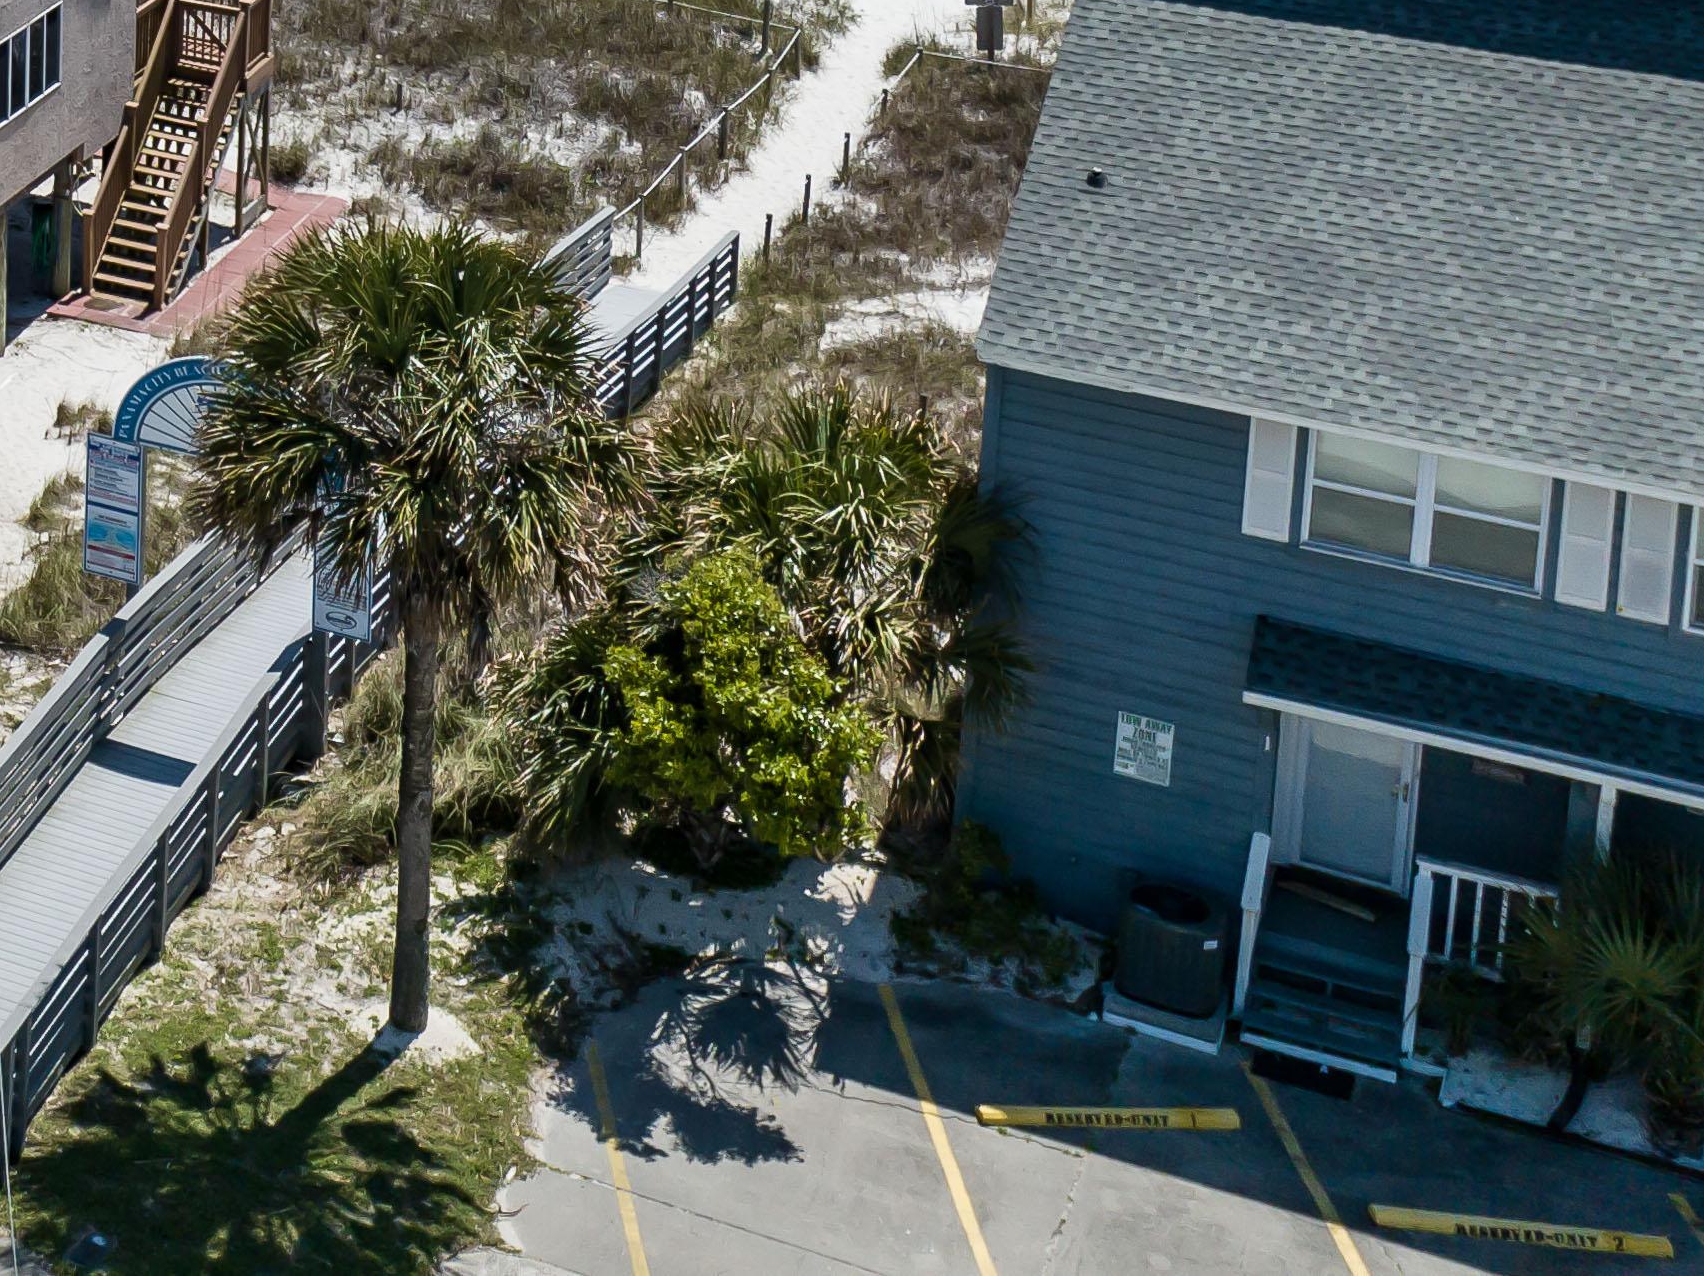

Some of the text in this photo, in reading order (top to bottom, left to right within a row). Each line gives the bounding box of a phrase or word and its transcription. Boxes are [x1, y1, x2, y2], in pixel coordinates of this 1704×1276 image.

[118, 389, 148, 438] PANAMA
[143, 370, 172, 392] CITY
[1144, 719, 1172, 734] AWAY
